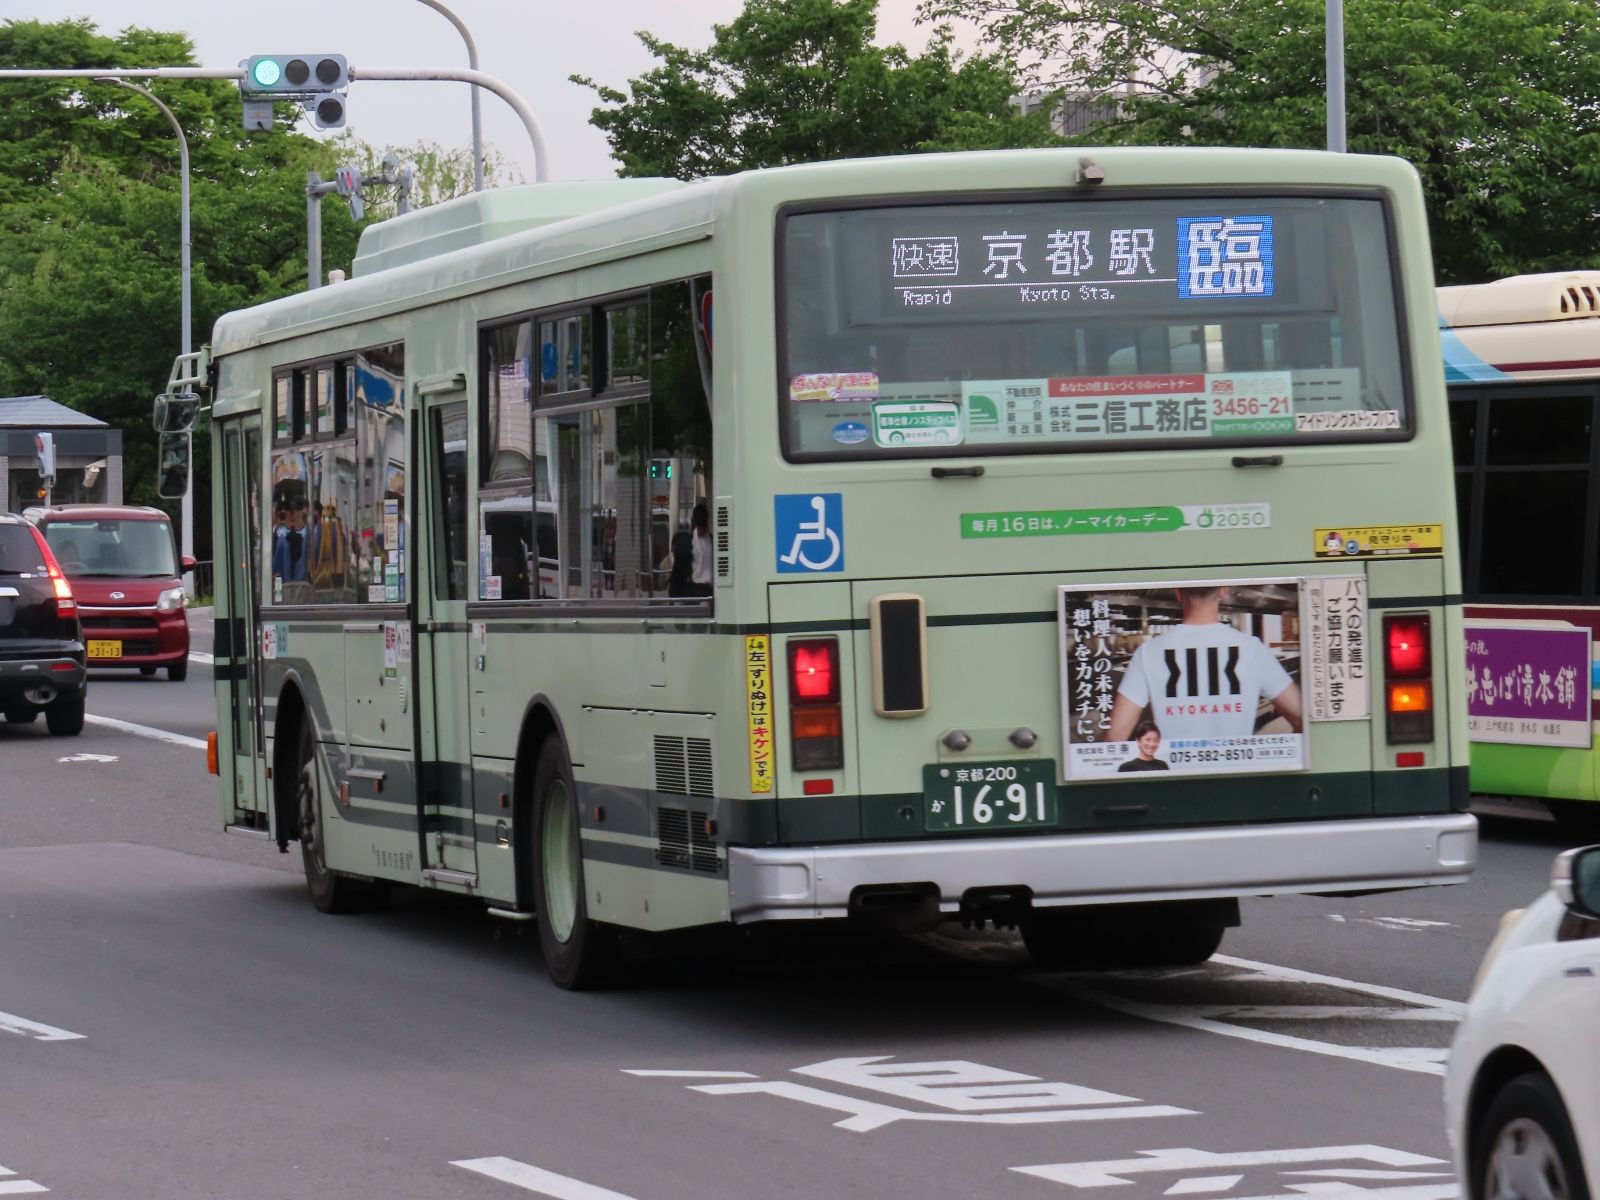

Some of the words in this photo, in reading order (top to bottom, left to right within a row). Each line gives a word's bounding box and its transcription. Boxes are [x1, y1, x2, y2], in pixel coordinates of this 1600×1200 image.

[897, 242, 954, 271] 快速
[982, 228, 1156, 278] 京都駅
[1188, 218, 1265, 295] 臨
[903, 289, 952, 306] Rapid
[1020, 286, 1071, 302] Kyoto
[1079, 285, 1115, 300] Sta.
[1075, 397, 1207, 434] 三信工務店
[1212, 397, 1290, 416] 3456-21
[1298, 411, 1397, 429] アイドリングストップバス
[971, 512, 1169, 533] 毎月16日は、ノーマイカーデー
[1216, 512, 1266, 527] 2050
[1346, 580, 1364, 680] バスの発進に
[1092, 599, 1114, 730] 料理人の未来と
[1327, 597, 1345, 715] ご協力願います
[1073, 608, 1096, 743] 想いをカタチに。
[748, 651, 769, 777] 左「すりぬけ」はキケンです
[1166, 702, 1243, 716] KYOKANE
[1169, 748, 1255, 764] 075-582-8510
[931, 800, 946, 813] か
[953, 782, 1046, 825] 16-91
